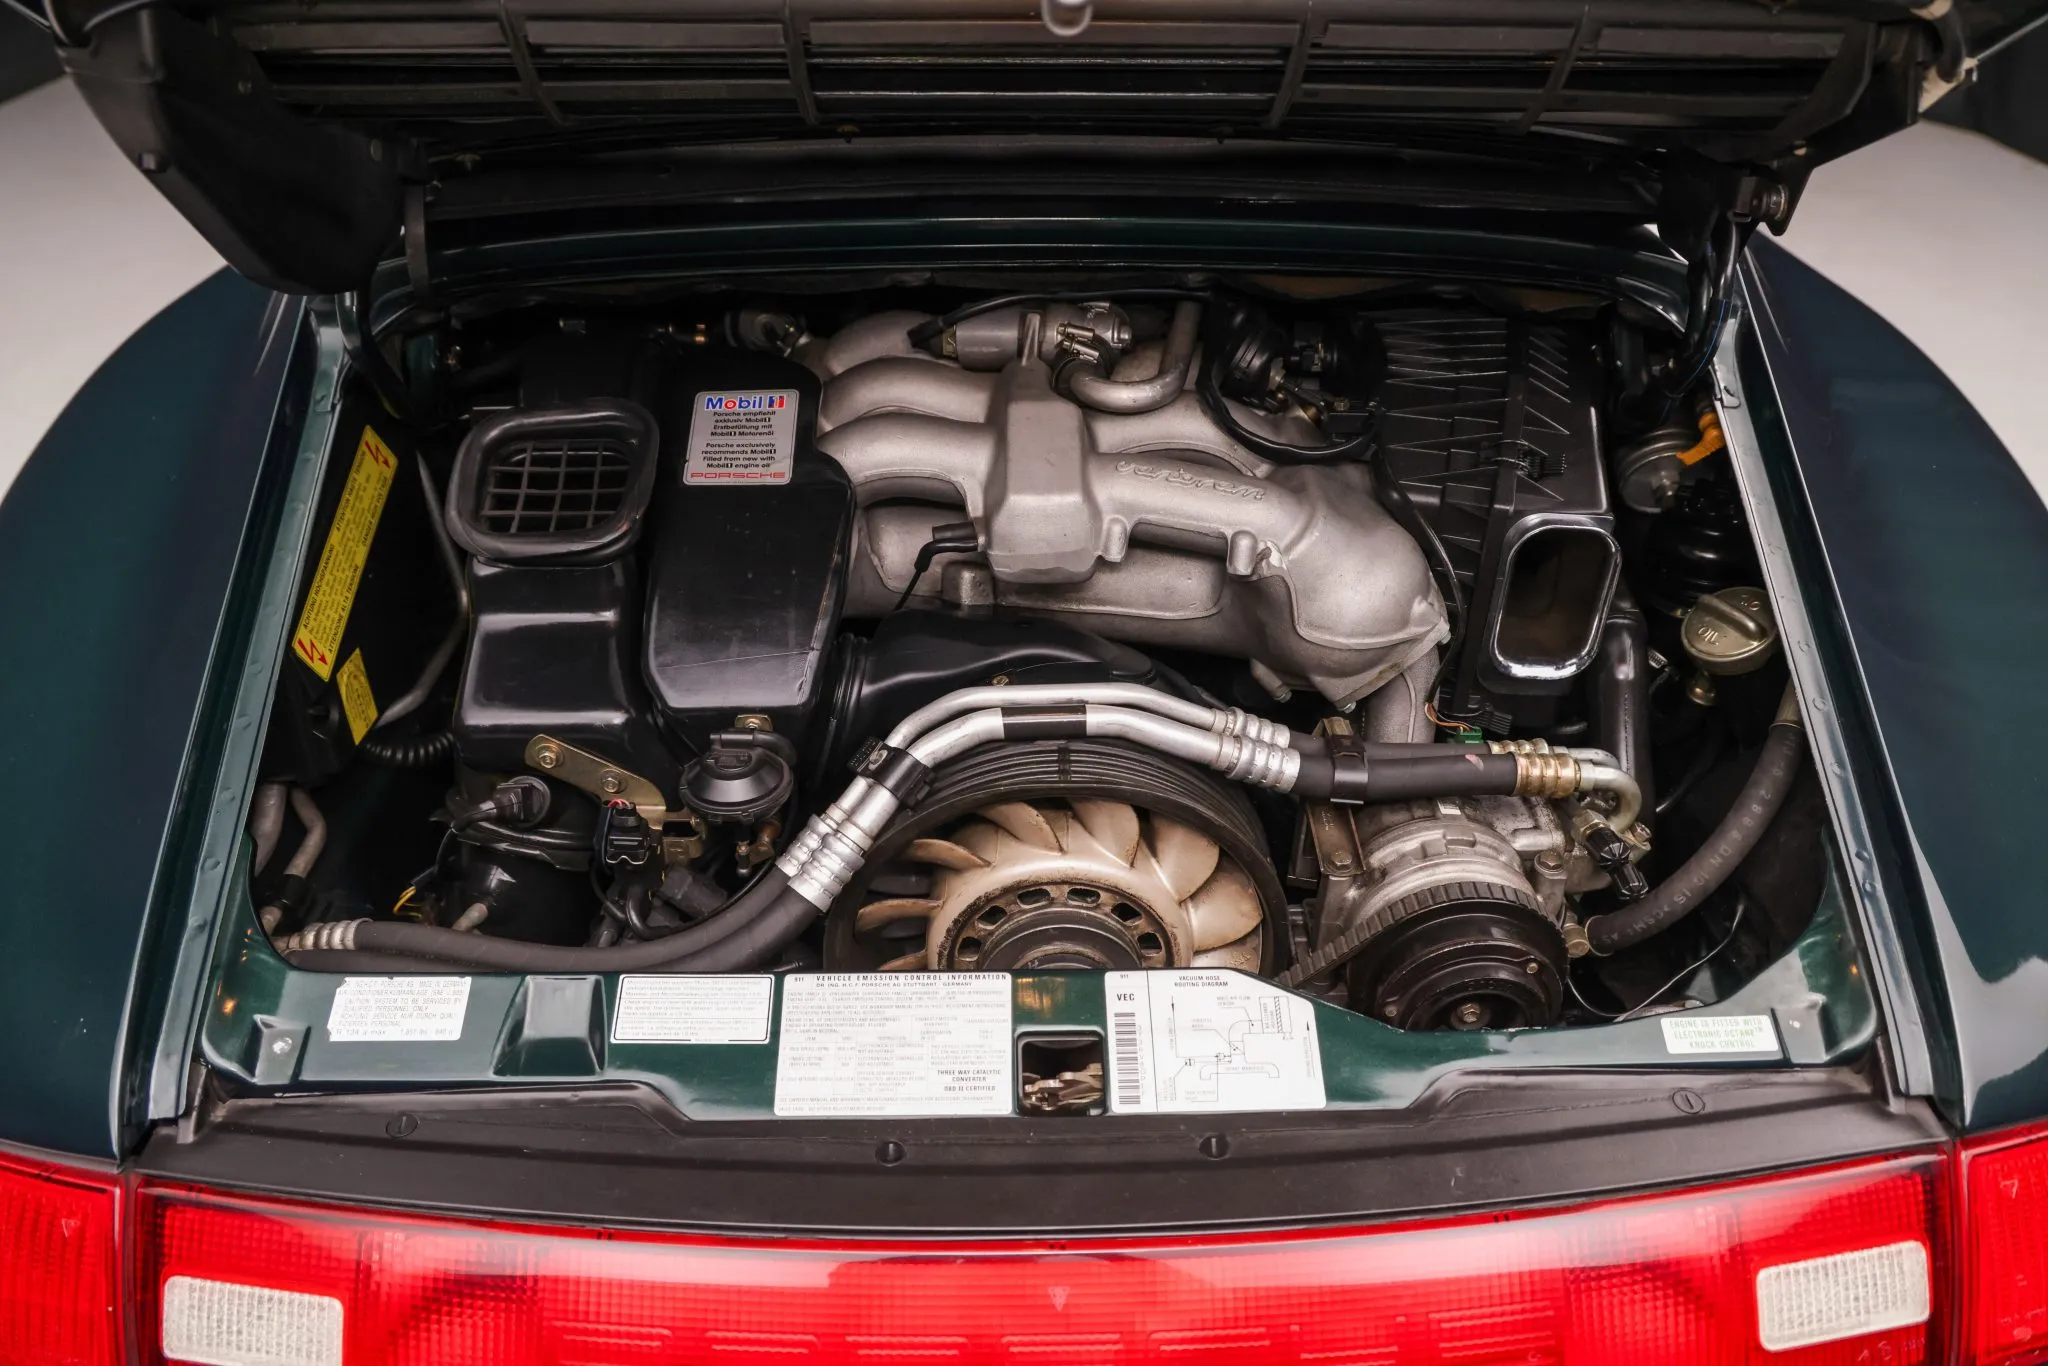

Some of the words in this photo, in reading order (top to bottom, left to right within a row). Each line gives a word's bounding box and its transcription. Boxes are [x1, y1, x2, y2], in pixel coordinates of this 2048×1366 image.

[704, 395, 763, 410] Mobil
[742, 410, 776, 418] empfiehlt
[302, 597, 317, 630] ACHTUNG
[816, 974, 852, 982] VEHICLE
[947, 973, 1007, 981] INFORMATION
[1116, 993, 1135, 1001] VEC
[1669, 1019, 1697, 1028] ENGINE
[1689, 1040, 1717, 1049] KNOCK
[1719, 1039, 1757, 1049] CONTROL
